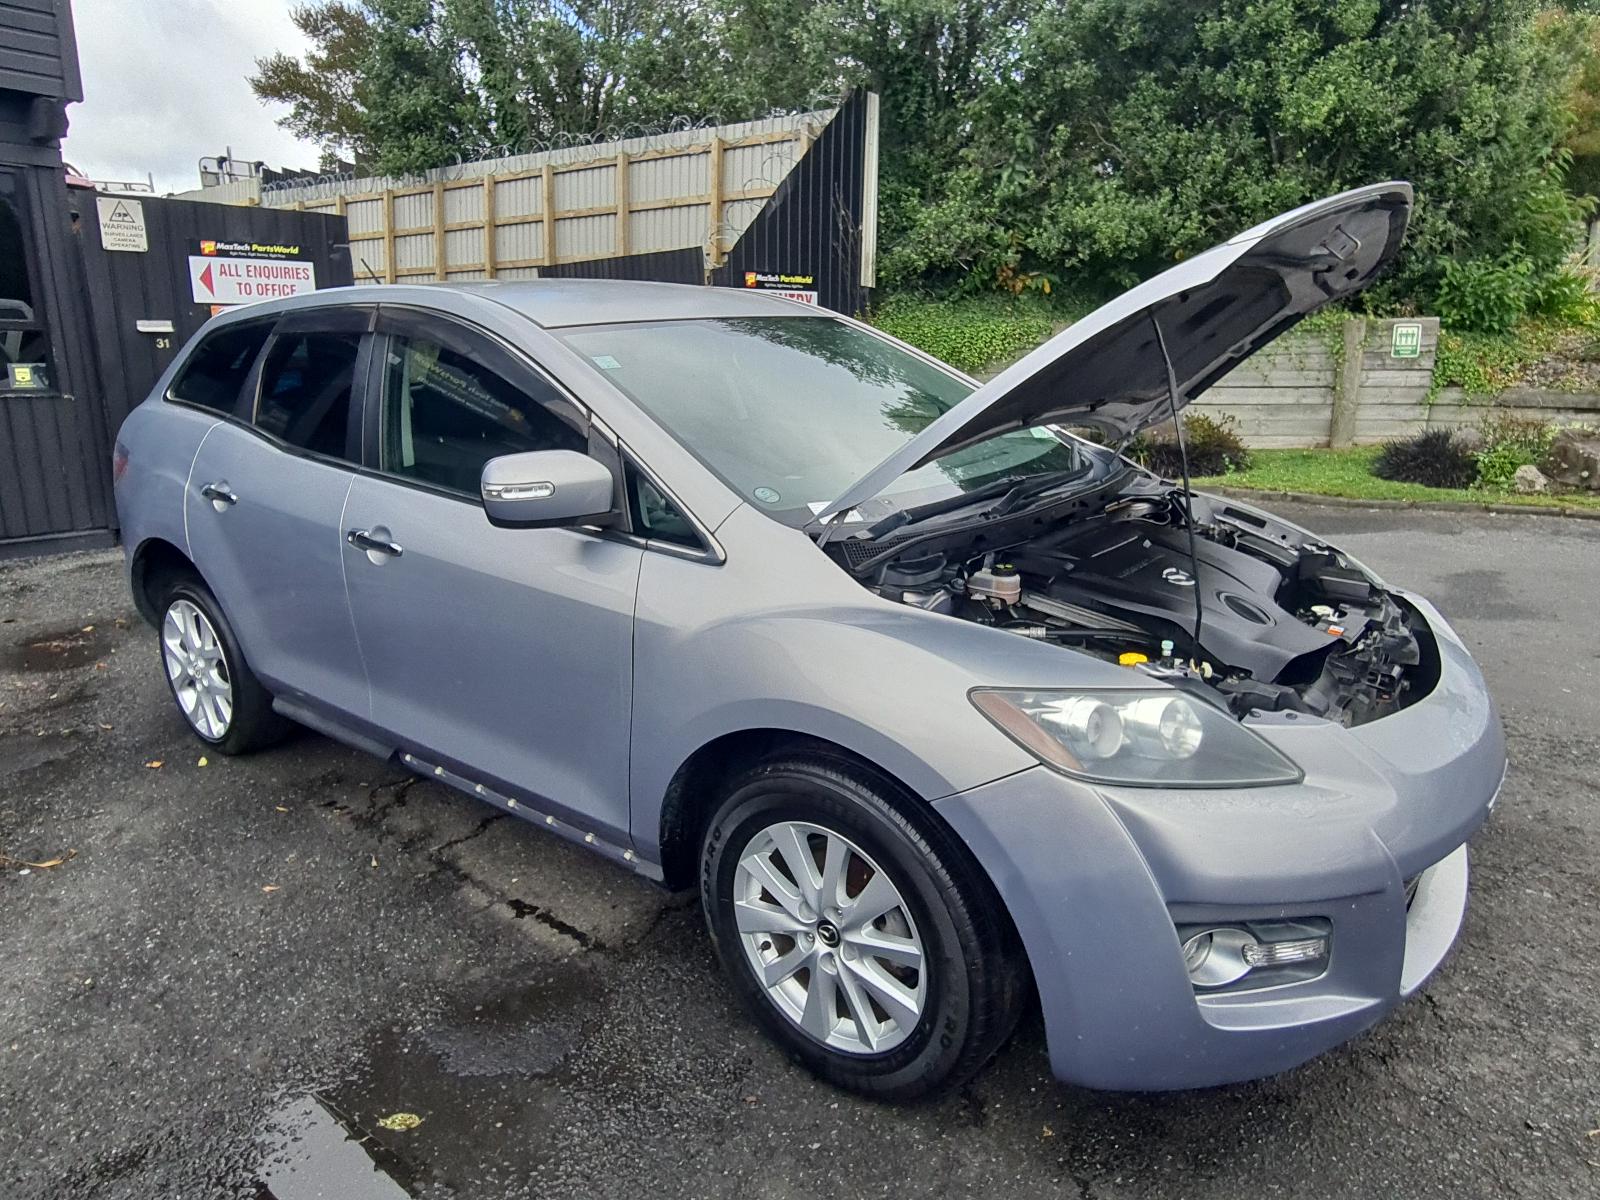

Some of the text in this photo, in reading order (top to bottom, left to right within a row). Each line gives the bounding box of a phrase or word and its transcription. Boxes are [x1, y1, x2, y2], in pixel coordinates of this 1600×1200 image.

[102, 222, 144, 232] WARNING
[216, 243, 250, 251] MaxTech
[251, 244, 299, 254] PartsWorld
[219, 263, 310, 281] ALL ENQUIRIES
[236, 282, 297, 297] TO OFFICE
[156, 338, 170, 349] 31
